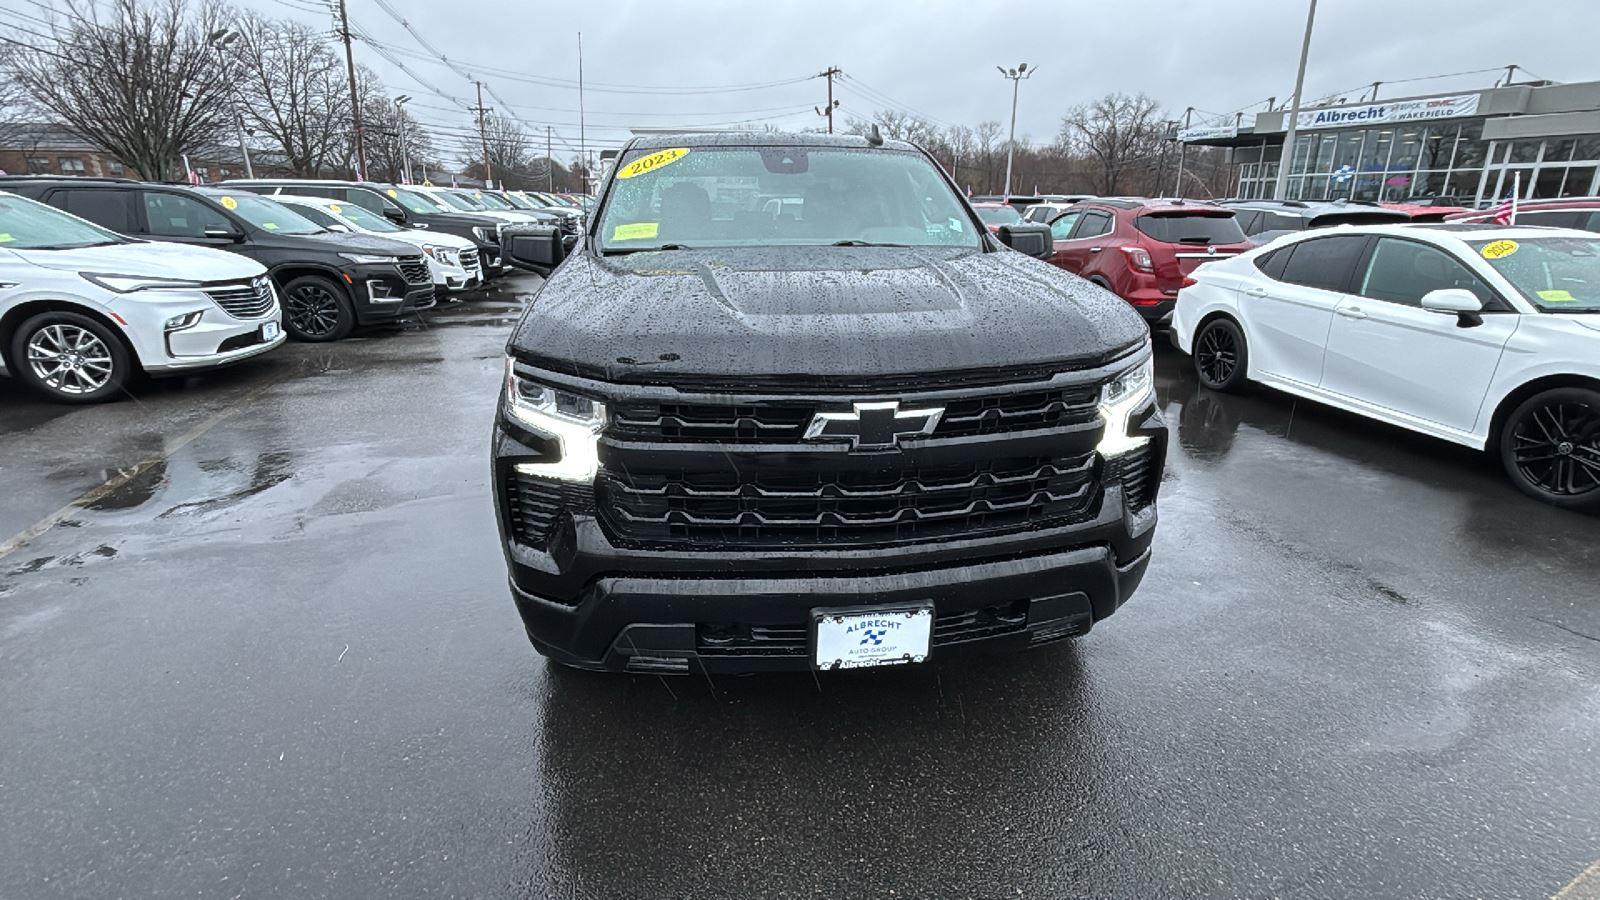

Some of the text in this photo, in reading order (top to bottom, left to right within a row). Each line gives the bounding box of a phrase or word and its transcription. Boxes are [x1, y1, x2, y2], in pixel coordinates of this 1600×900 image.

[1314, 106, 1385, 124] Albrecht
[1399, 109, 1454, 119] WAKEFIELD
[631, 150, 677, 174] 2023
[846, 620, 902, 634] ALBRECHT
[870, 645, 897, 653] GROUP
[839, 658, 881, 669] Albrecht
